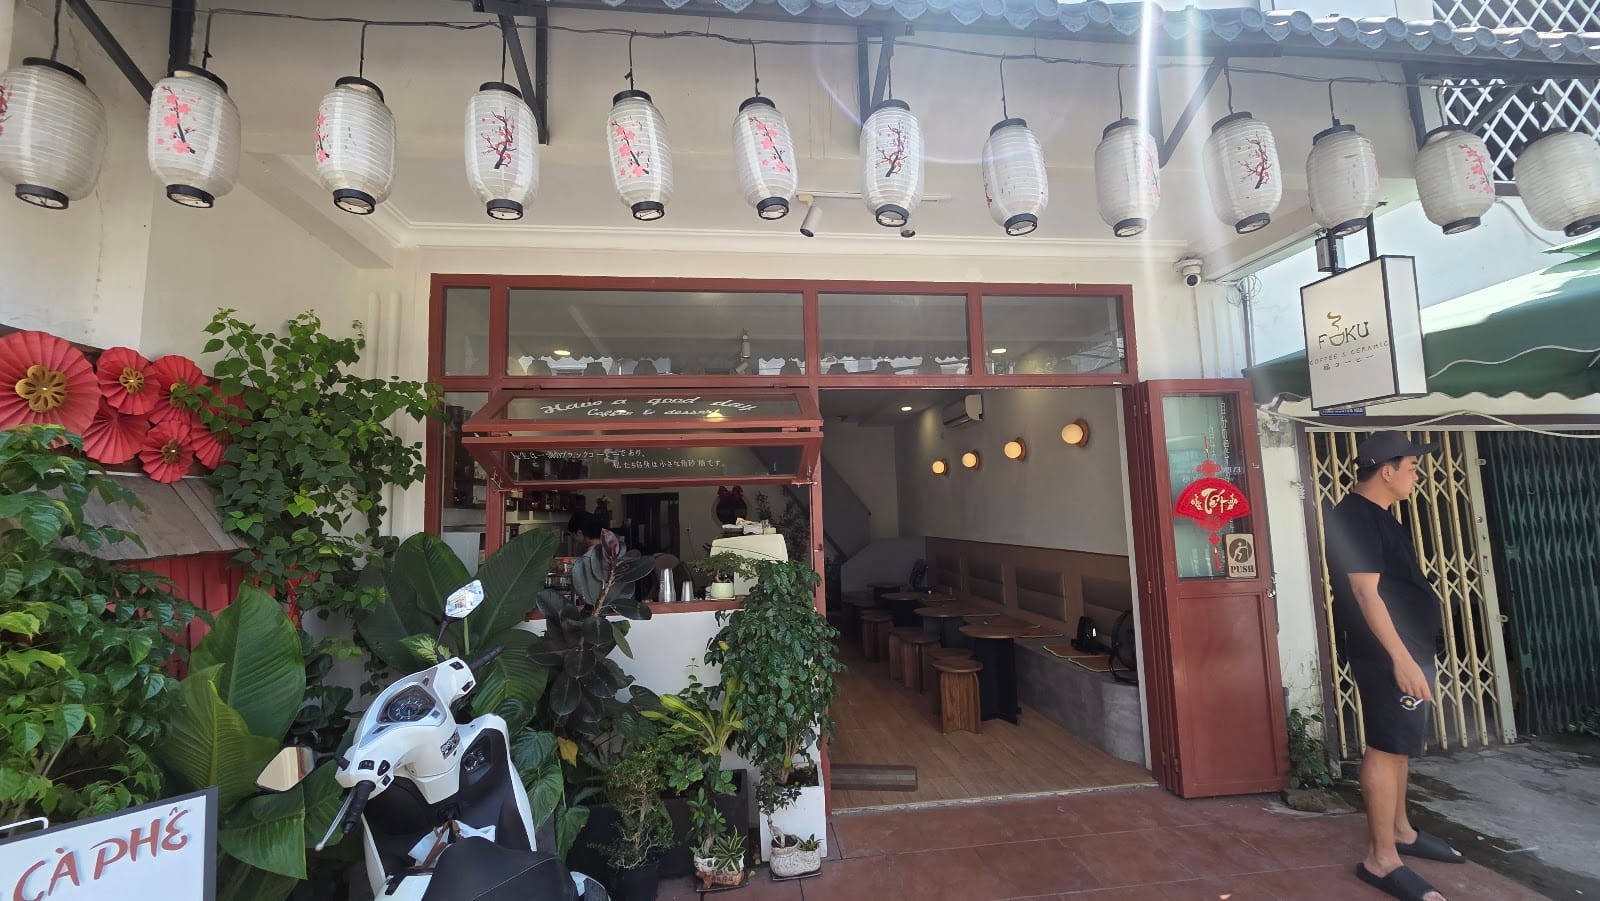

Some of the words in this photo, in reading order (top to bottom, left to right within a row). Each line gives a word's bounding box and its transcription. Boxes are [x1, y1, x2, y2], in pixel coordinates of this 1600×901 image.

[1309, 353, 1338, 367] COFFEE
[1350, 340, 1389, 356] CERAMIC
[539, 399, 603, 414] Have
[647, 396, 701, 405] good
[709, 399, 757, 411] day
[586, 408, 634, 418] Coffee
[1230, 565, 1255, 574] PUSH
[13, 847, 81, 901] CÀ
[90, 806, 189, 881] PHÊ
